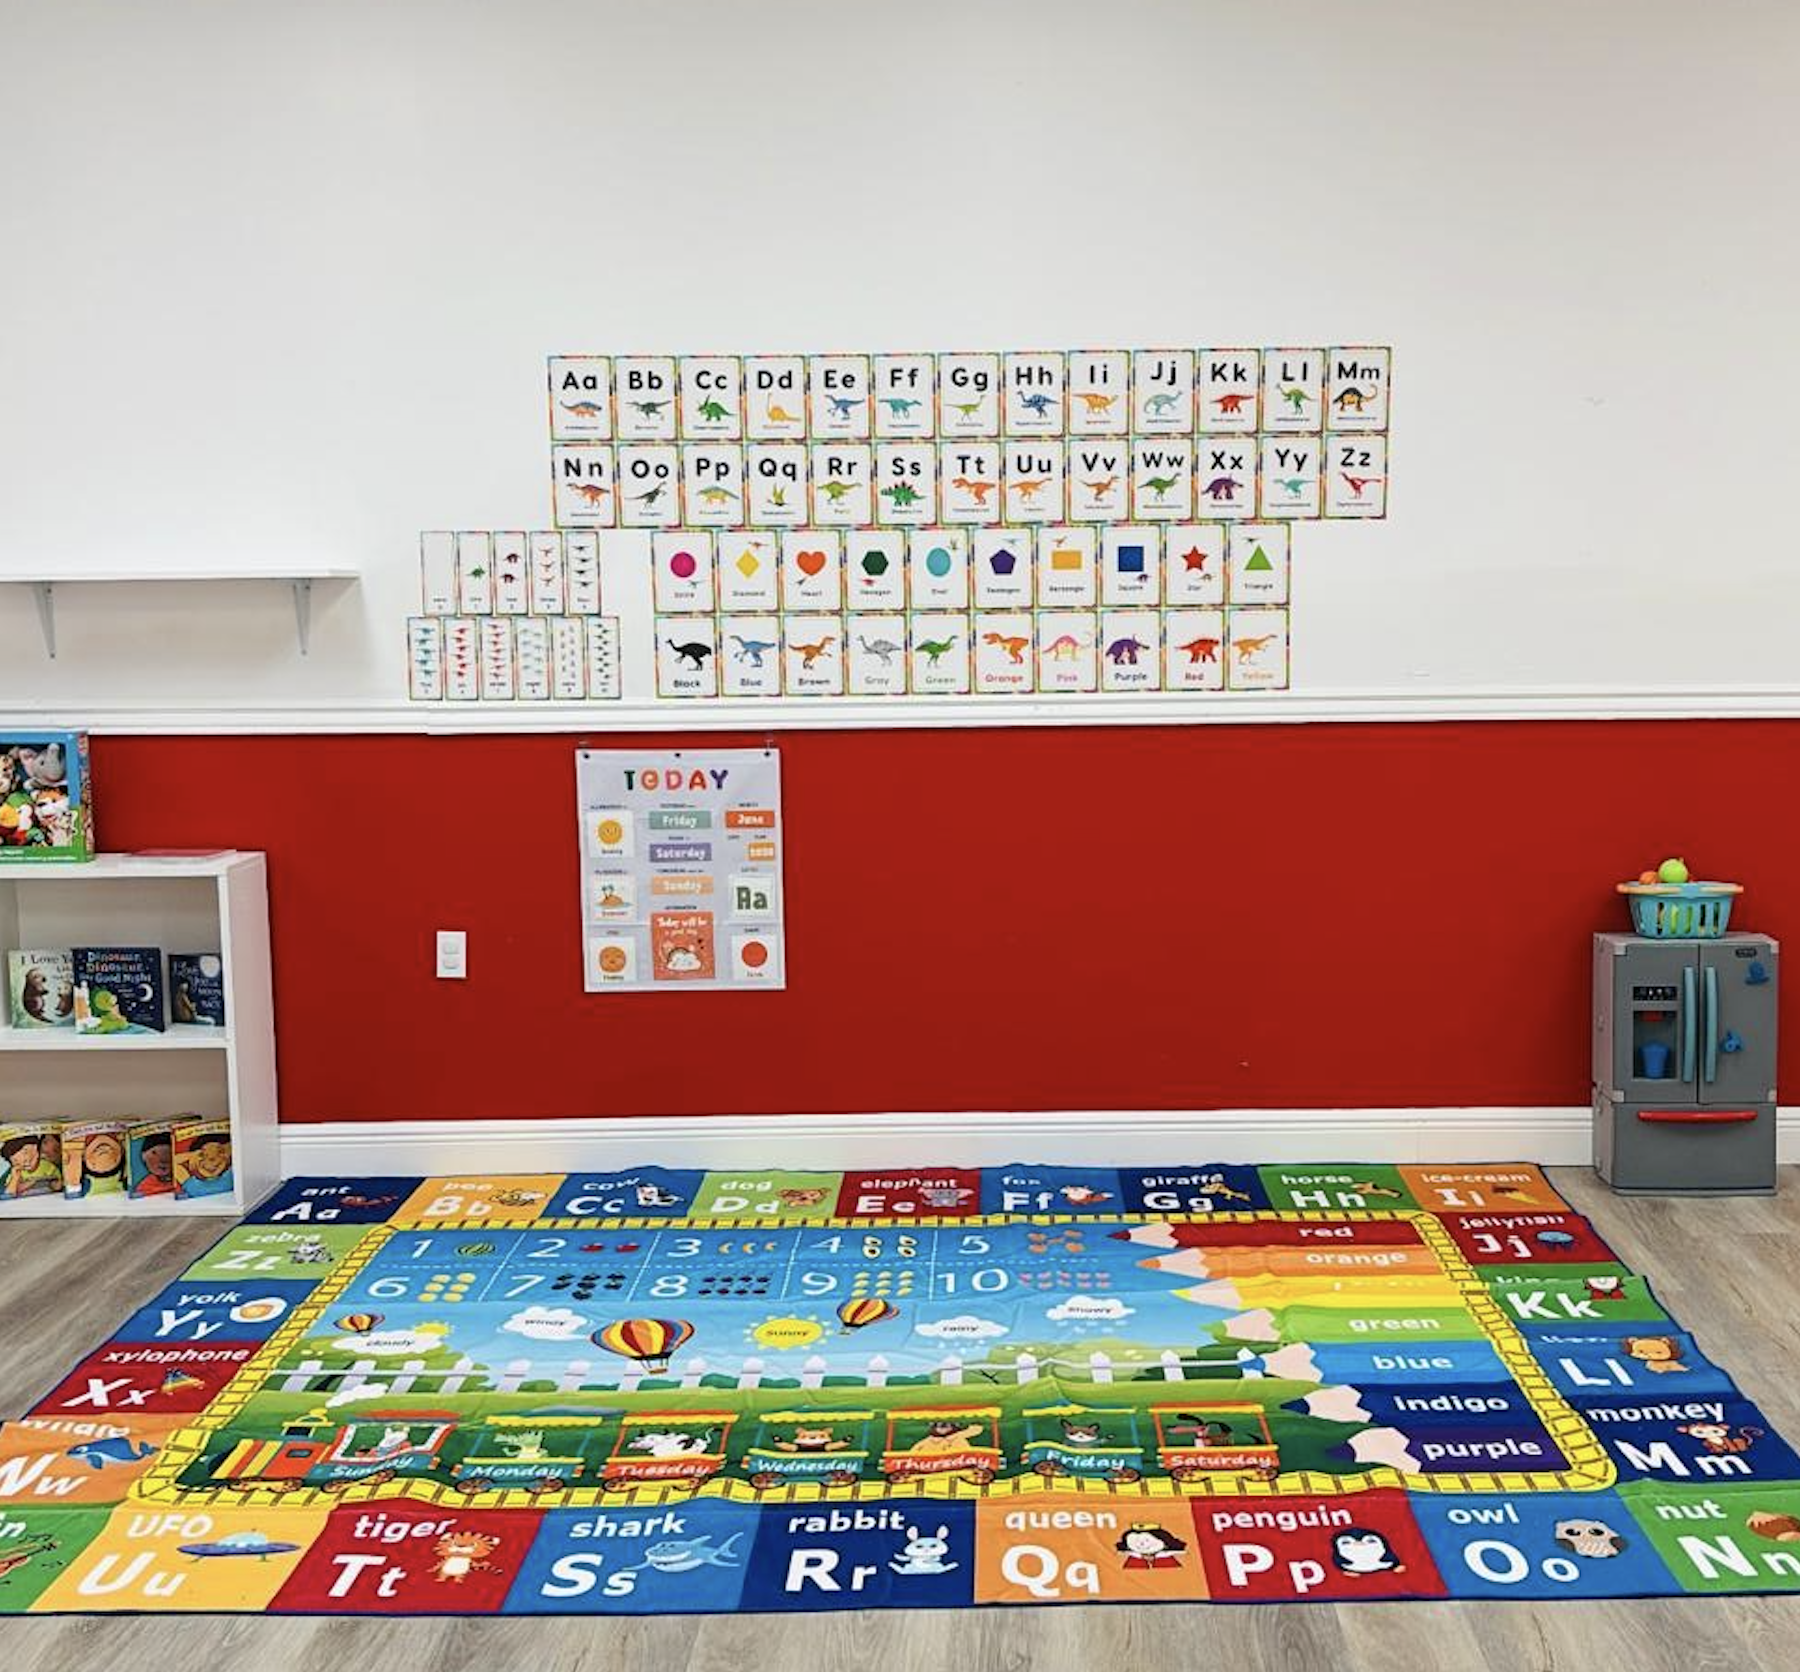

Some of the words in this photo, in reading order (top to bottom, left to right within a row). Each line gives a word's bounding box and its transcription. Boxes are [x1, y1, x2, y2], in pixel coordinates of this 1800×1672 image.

[562, 371, 597, 390] Aa
[629, 371, 663, 390] Bb
[695, 370, 728, 390] Cc
[757, 370, 792, 389] Dd
[824, 370, 856, 388] Ee
[890, 368, 919, 387] Ff
[951, 367, 988, 391] Gg
[1015, 366, 1053, 386] Hh
[1090, 364, 1108, 384] Ii
[1150, 361, 1177, 385] Jj
[1211, 363, 1247, 382] Kk
[1282, 361, 1308, 381] Ll
[1338, 361, 1380, 381] Mm
[828, 457, 859, 476] Rr
[891, 457, 921, 476] Ss
[957, 455, 986, 474] Tt
[1017, 455, 1052, 474] Uu
[1081, 452, 1117, 471] Vv
[1142, 452, 1184, 469] Ww
[1210, 451, 1244, 470] Xx
[1275, 449, 1308, 472] Yy
[1341, 448, 1371, 467] Zz
[564, 458, 603, 478] Nn
[631, 459, 669, 478] Oo
[696, 458, 730, 481] Pp
[758, 458, 797, 482] Qq
[798, 677, 831, 686] Brown
[985, 674, 1024, 685] Orange
[1114, 672, 1148, 683] Purple
[1185, 671, 1204, 681] Red
[624, 769, 728, 791] TODAY
[662, 815, 697, 828] Friday
[737, 813, 764, 825] June
[655, 847, 706, 860] Saturday
[663, 880, 702, 893] Sunday
[582, 1177, 639, 1191] cow
[720, 1179, 772, 1192] dog
[860, 1177, 957, 1190] elephant
[1142, 1173, 1224, 1187] giraffe
[1420, 1172, 1532, 1184] ice-cream
[422, 1196, 493, 1217] Bb
[564, 1196, 624, 1216] Cc
[709, 1196, 779, 1214] Dd
[856, 1195, 916, 1213] Ee
[1003, 1191, 1054, 1211] Ff
[1143, 1191, 1214, 1212] Gg
[1289, 1190, 1366, 1208] Hh
[270, 1201, 341, 1221] Aa
[243, 1231, 321, 1244] zebra
[1299, 1226, 1354, 1238] red
[412, 1238, 434, 1258] 1
[527, 1238, 567, 1258] 2
[667, 1238, 702, 1258] 3
[810, 1236, 845, 1253] 4
[959, 1234, 990, 1254] 5
[1471, 1233, 1532, 1258] Jj
[212, 1250, 282, 1271] Zz
[1306, 1251, 1408, 1267] orange
[367, 1276, 411, 1298] 6
[502, 1274, 546, 1298] 7
[650, 1275, 690, 1297] 8
[802, 1271, 838, 1295] 9
[937, 1268, 1009, 1295] 10
[176, 1290, 242, 1306] yolk
[1506, 1291, 1604, 1319] Kk
[155, 1309, 224, 1341] Yy
[1349, 1316, 1441, 1332] green
[101, 1348, 249, 1364] xylophone
[1373, 1355, 1454, 1369] blue
[1558, 1358, 1635, 1387] Ll
[60, 1378, 157, 1407] Xx
[1394, 1395, 1510, 1413] indigo
[1586, 1402, 1727, 1422] monkey
[1423, 1438, 1543, 1460] purple
[1614, 1441, 1754, 1477] Mm
[618, 1462, 711, 1477] Tuesday
[757, 1458, 858, 1473] Wednesday
[893, 1454, 991, 1470] Thursday
[1047, 1450, 1125, 1470] Friday
[1171, 1453, 1271, 1468] Saturday
[470, 1464, 563, 1479] Monday
[1212, 1504, 1352, 1532] penguin
[1447, 1502, 1519, 1525] owl
[1655, 1499, 1728, 1521] nut
[127, 1514, 214, 1539] UFO
[353, 1513, 457, 1543] tiger
[569, 1512, 686, 1538] shark
[788, 1509, 905, 1534] rabbit
[1005, 1510, 1117, 1532] queen
[1463, 1539, 1580, 1583] Oo
[1677, 1535, 1800, 1579] Nn
[77, 1552, 188, 1597] Uu
[328, 1553, 406, 1598] Tt
[540, 1553, 637, 1597] Ss
[785, 1548, 878, 1592] Rr
[1001, 1544, 1100, 1598] Qq
[1222, 1544, 1325, 1594] Pp
